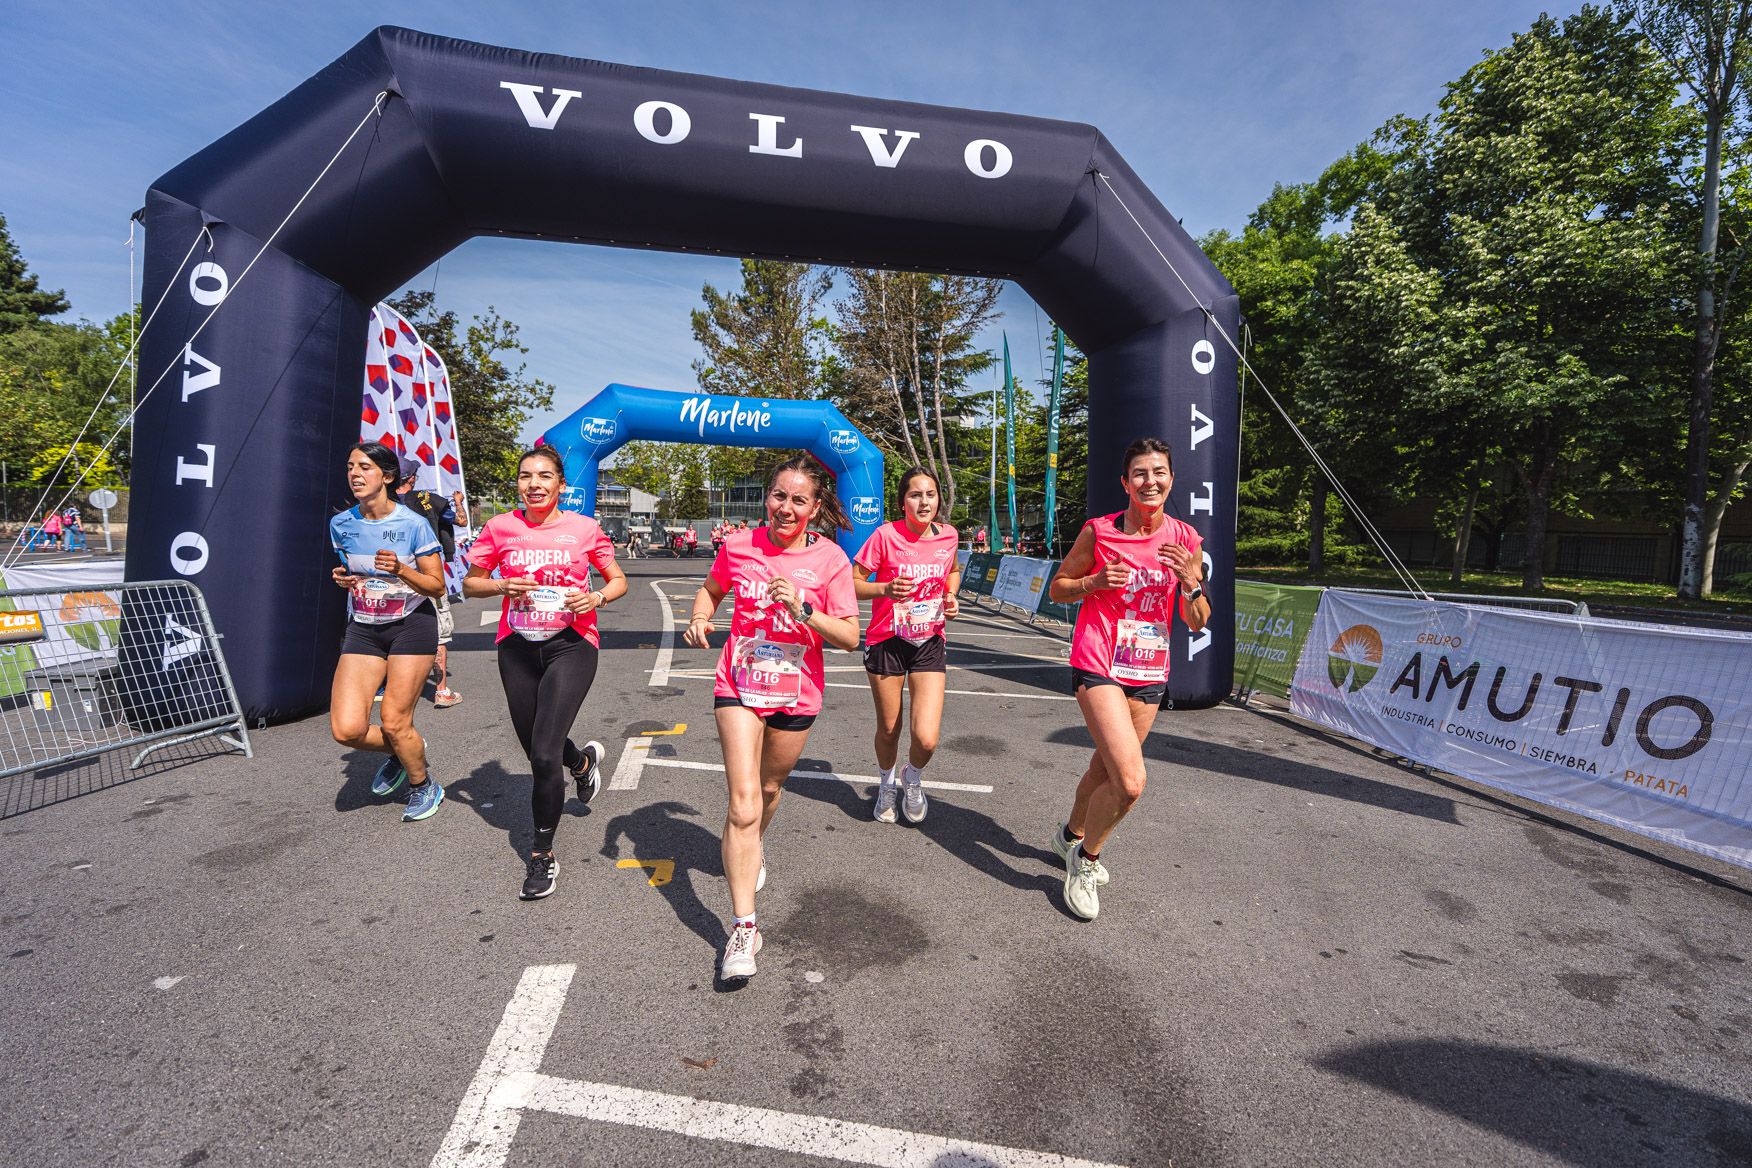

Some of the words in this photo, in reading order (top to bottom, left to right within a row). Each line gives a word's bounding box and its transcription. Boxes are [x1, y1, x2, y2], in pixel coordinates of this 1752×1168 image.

[500, 81, 1013, 179] VOLVO
[680, 397, 770, 438] Marlene
[584, 422, 614, 436] Marlene
[832, 435, 857, 447] Marlene
[163, 261, 229, 671] VOLVO
[853, 502, 879, 516] Marlene
[509, 549, 571, 566] CARRERA
[741, 563, 769, 572] OYSHO
[898, 564, 945, 578] CARRERA
[365, 598, 387, 608] 016
[0, 615, 36, 627] tos
[530, 611, 555, 621] 016
[912, 623, 930, 632] 016
[1254, 616, 1294, 639] CASA
[1416, 632, 1462, 648] GRUPO
[1135, 649, 1155, 659] 016
[1235, 639, 1288, 662] onfianza
[753, 670, 780, 684] 016
[1118, 669, 1138, 677] OYSHO
[1390, 652, 1714, 760] AMUTIO
[1381, 705, 1435, 729] INDUSTRIA
[1446, 723, 1517, 751] CONSUMO
[1529, 746, 1598, 775] SIEMBRA
[1624, 770, 1689, 798] PATATA
